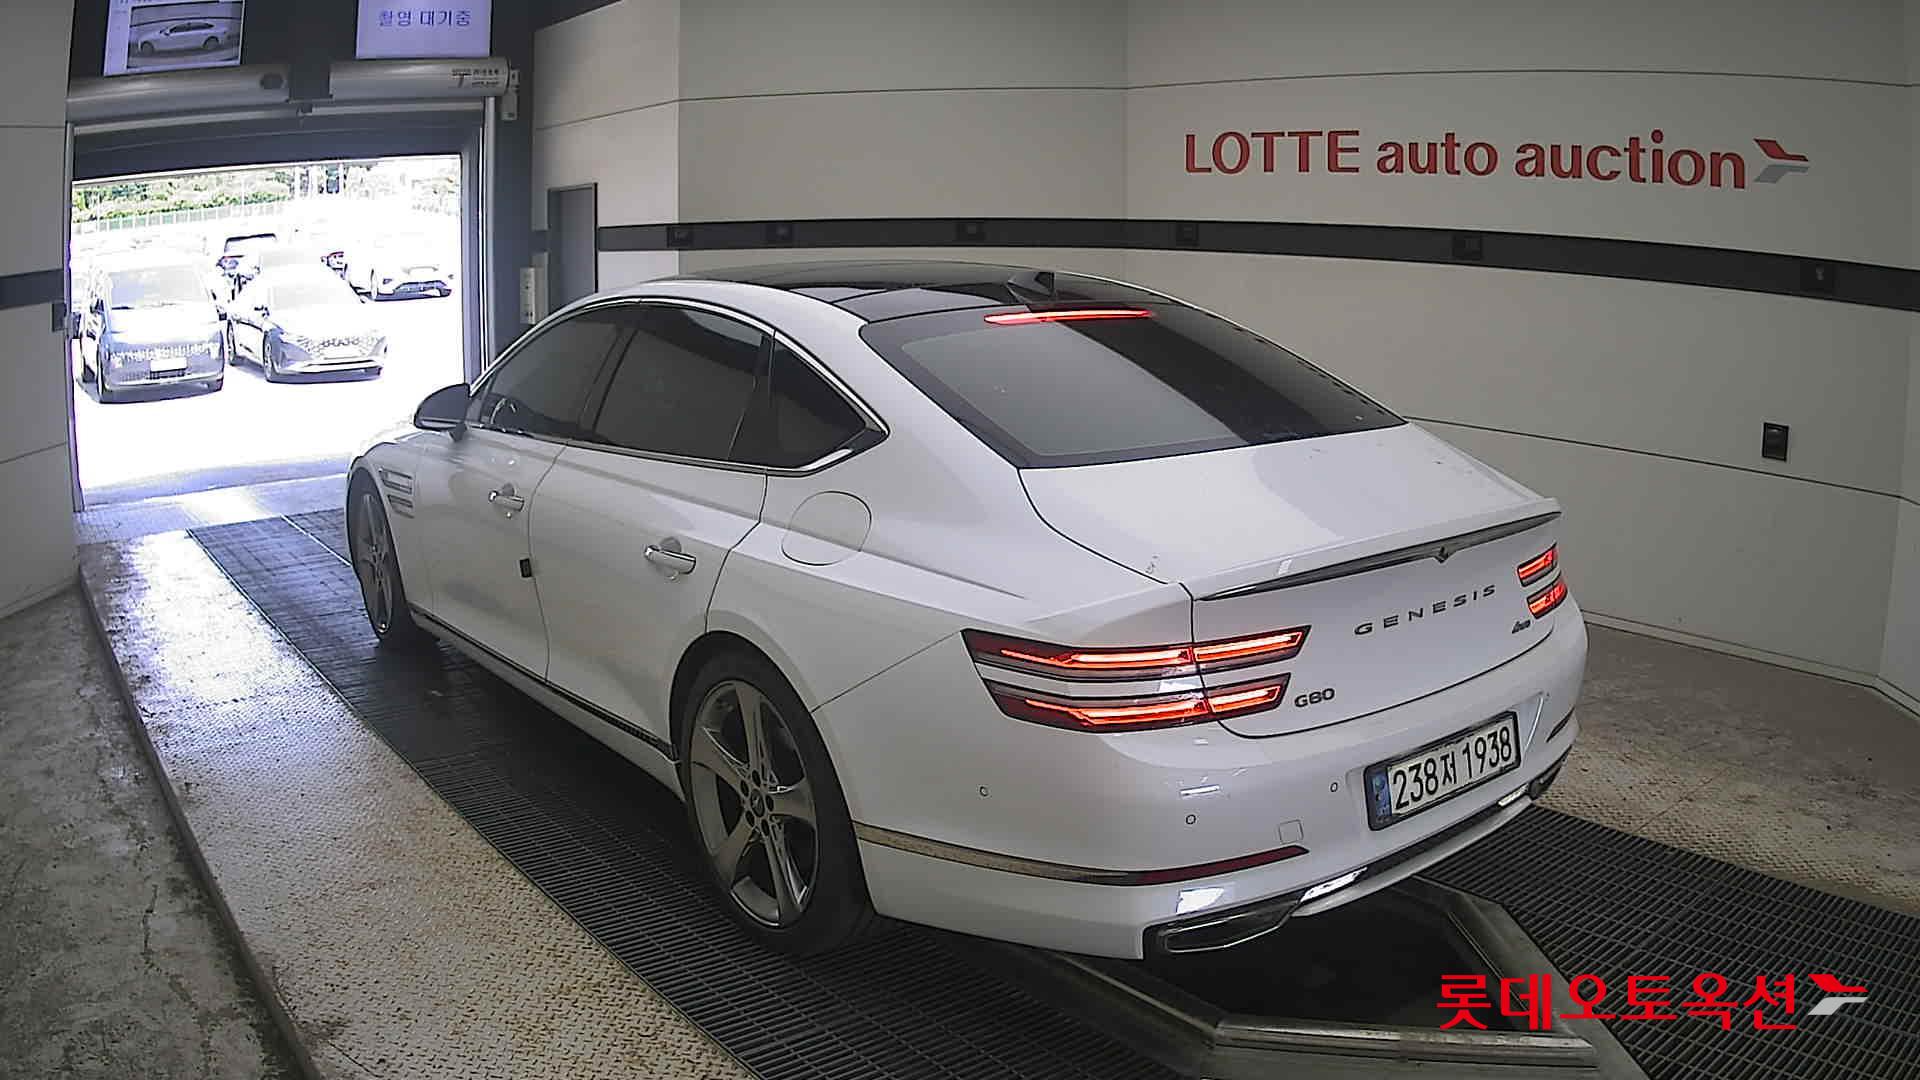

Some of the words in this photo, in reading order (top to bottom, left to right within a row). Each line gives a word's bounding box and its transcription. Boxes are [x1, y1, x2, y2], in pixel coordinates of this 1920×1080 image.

[420, 10, 471, 27] 대기중
[1185, 130, 1361, 174] LOTTE
[1377, 132, 1498, 177] auto
[1515, 130, 1746, 189] auction
[1354, 584, 1496, 635] GENESIS
[1294, 687, 1336, 708] G80
